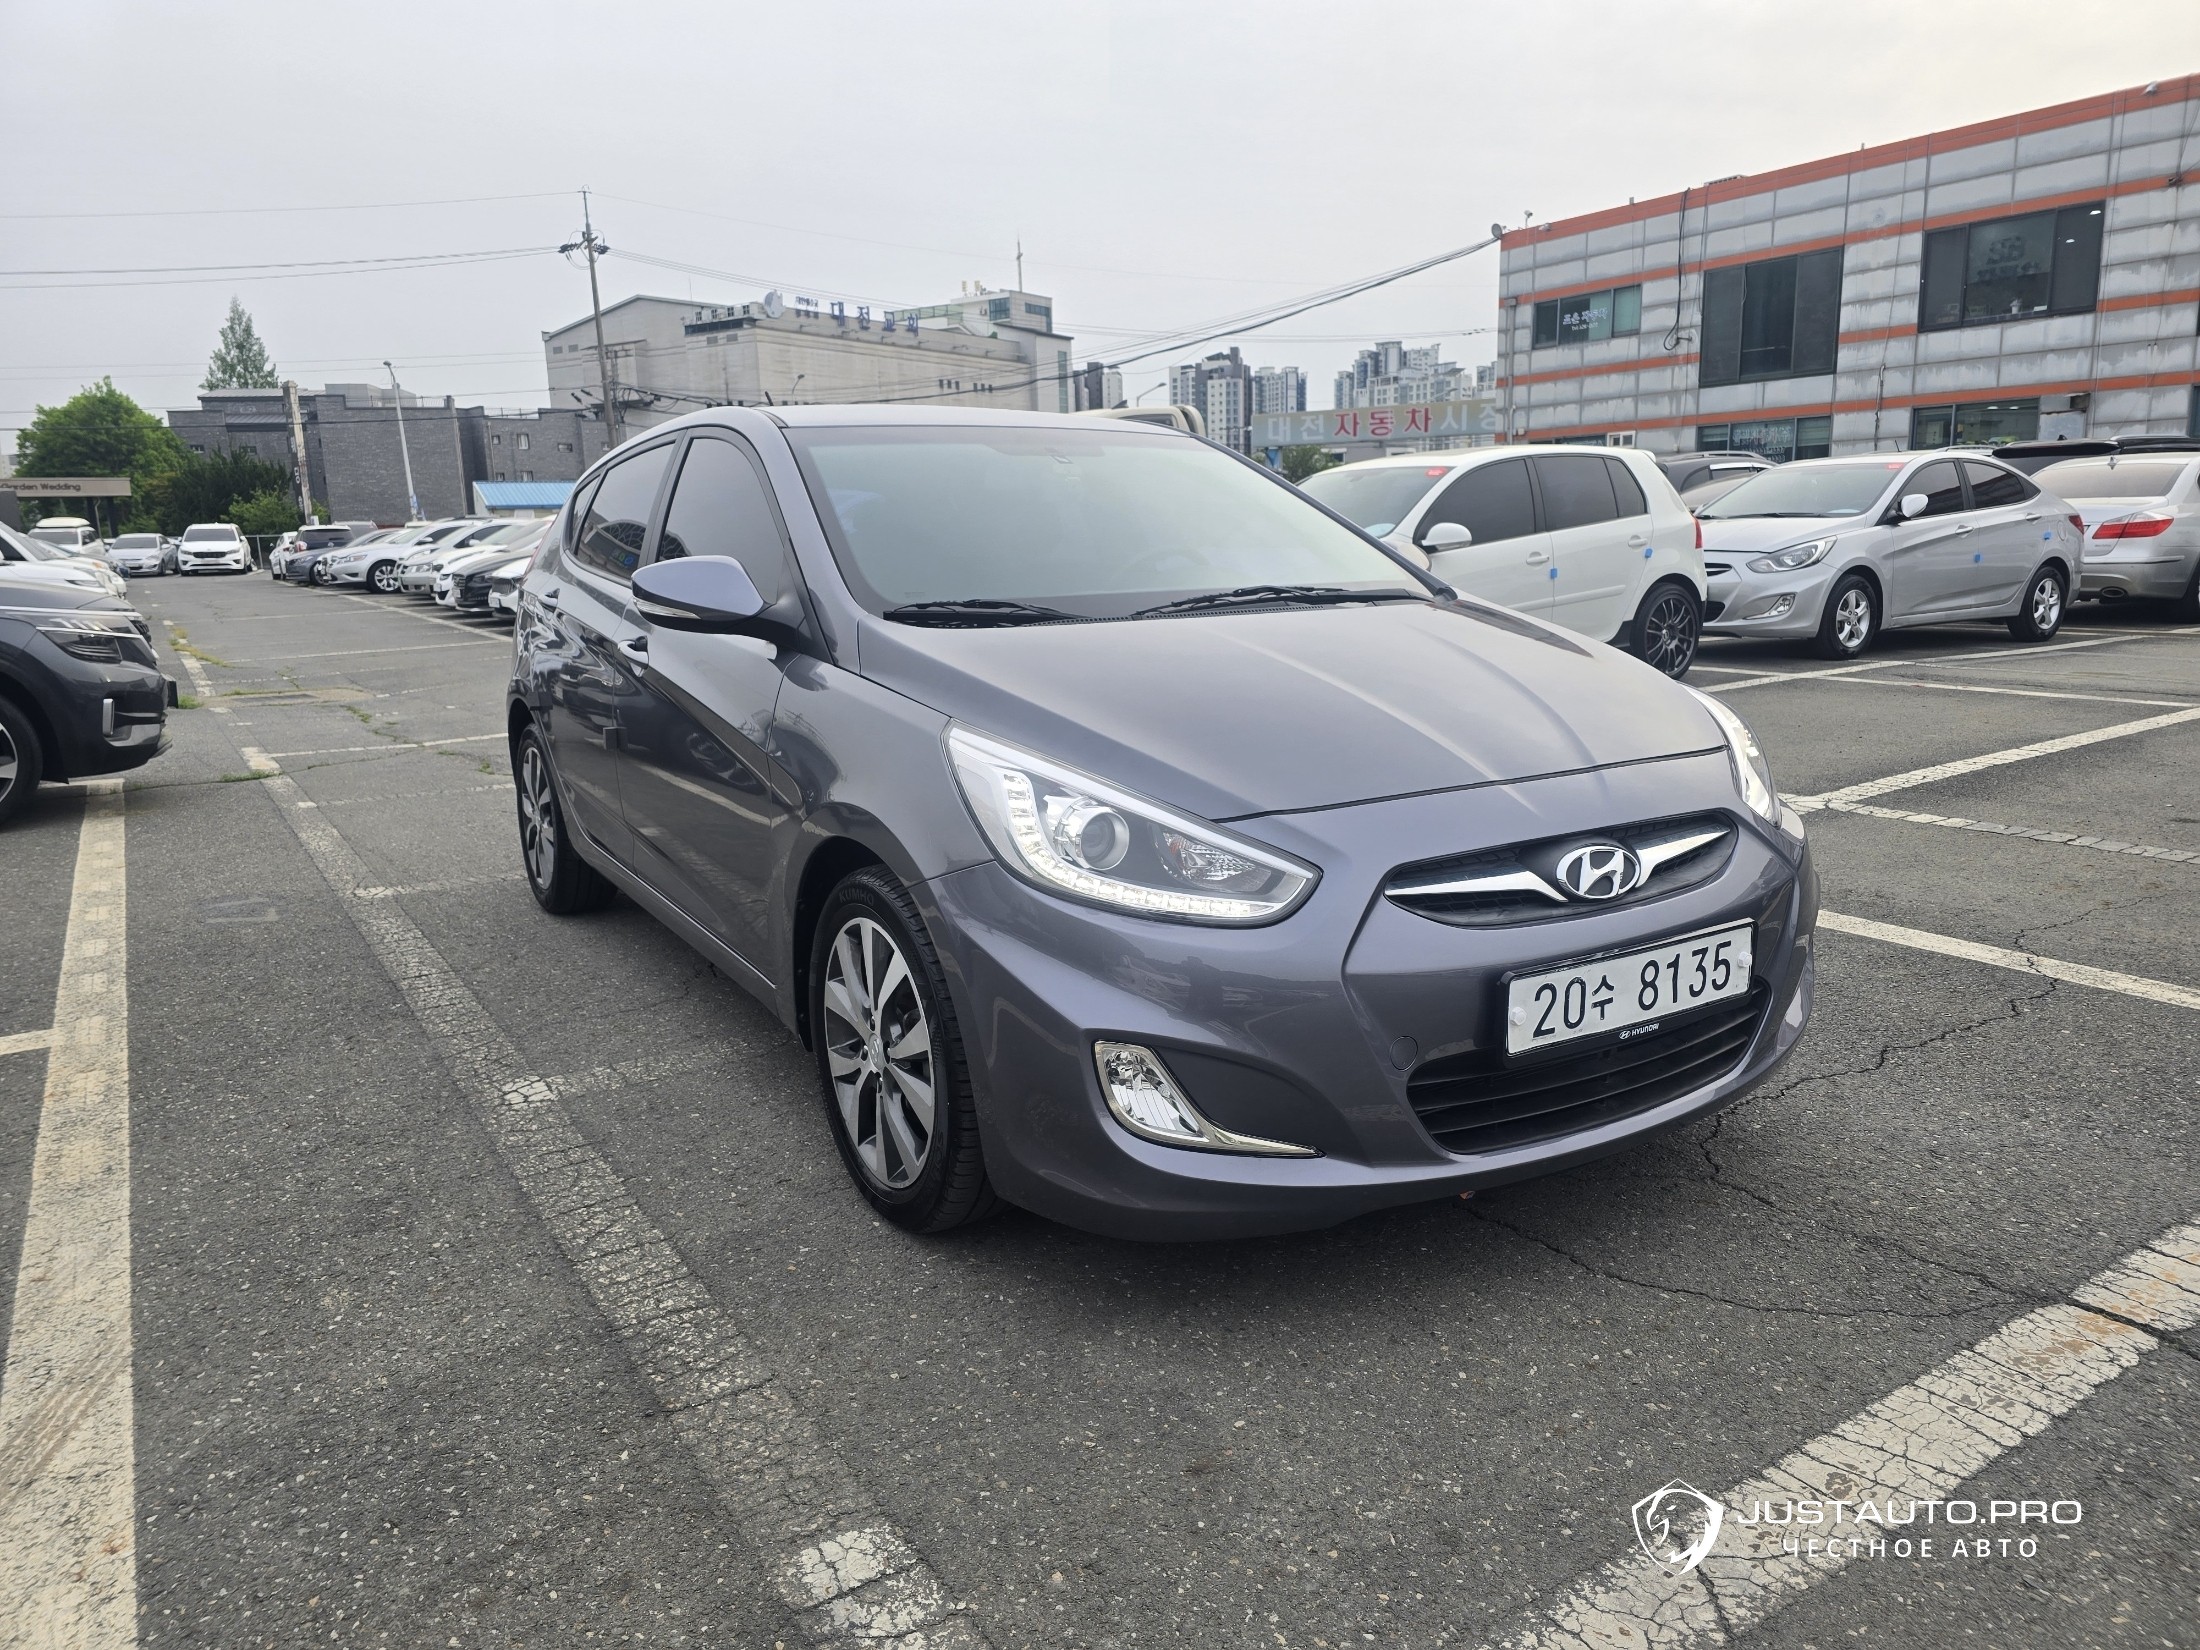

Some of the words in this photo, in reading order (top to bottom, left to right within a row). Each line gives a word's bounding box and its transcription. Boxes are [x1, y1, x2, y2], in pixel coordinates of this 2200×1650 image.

[1334, 407, 1433, 438] 자동차
[40, 483, 81, 492] Wedding
[839, 888, 874, 906] KUMHO
[1532, 974, 1615, 1038] 20수
[1637, 940, 1732, 1011] 8135
[1631, 1023, 1660, 1037] HYUNDAI
